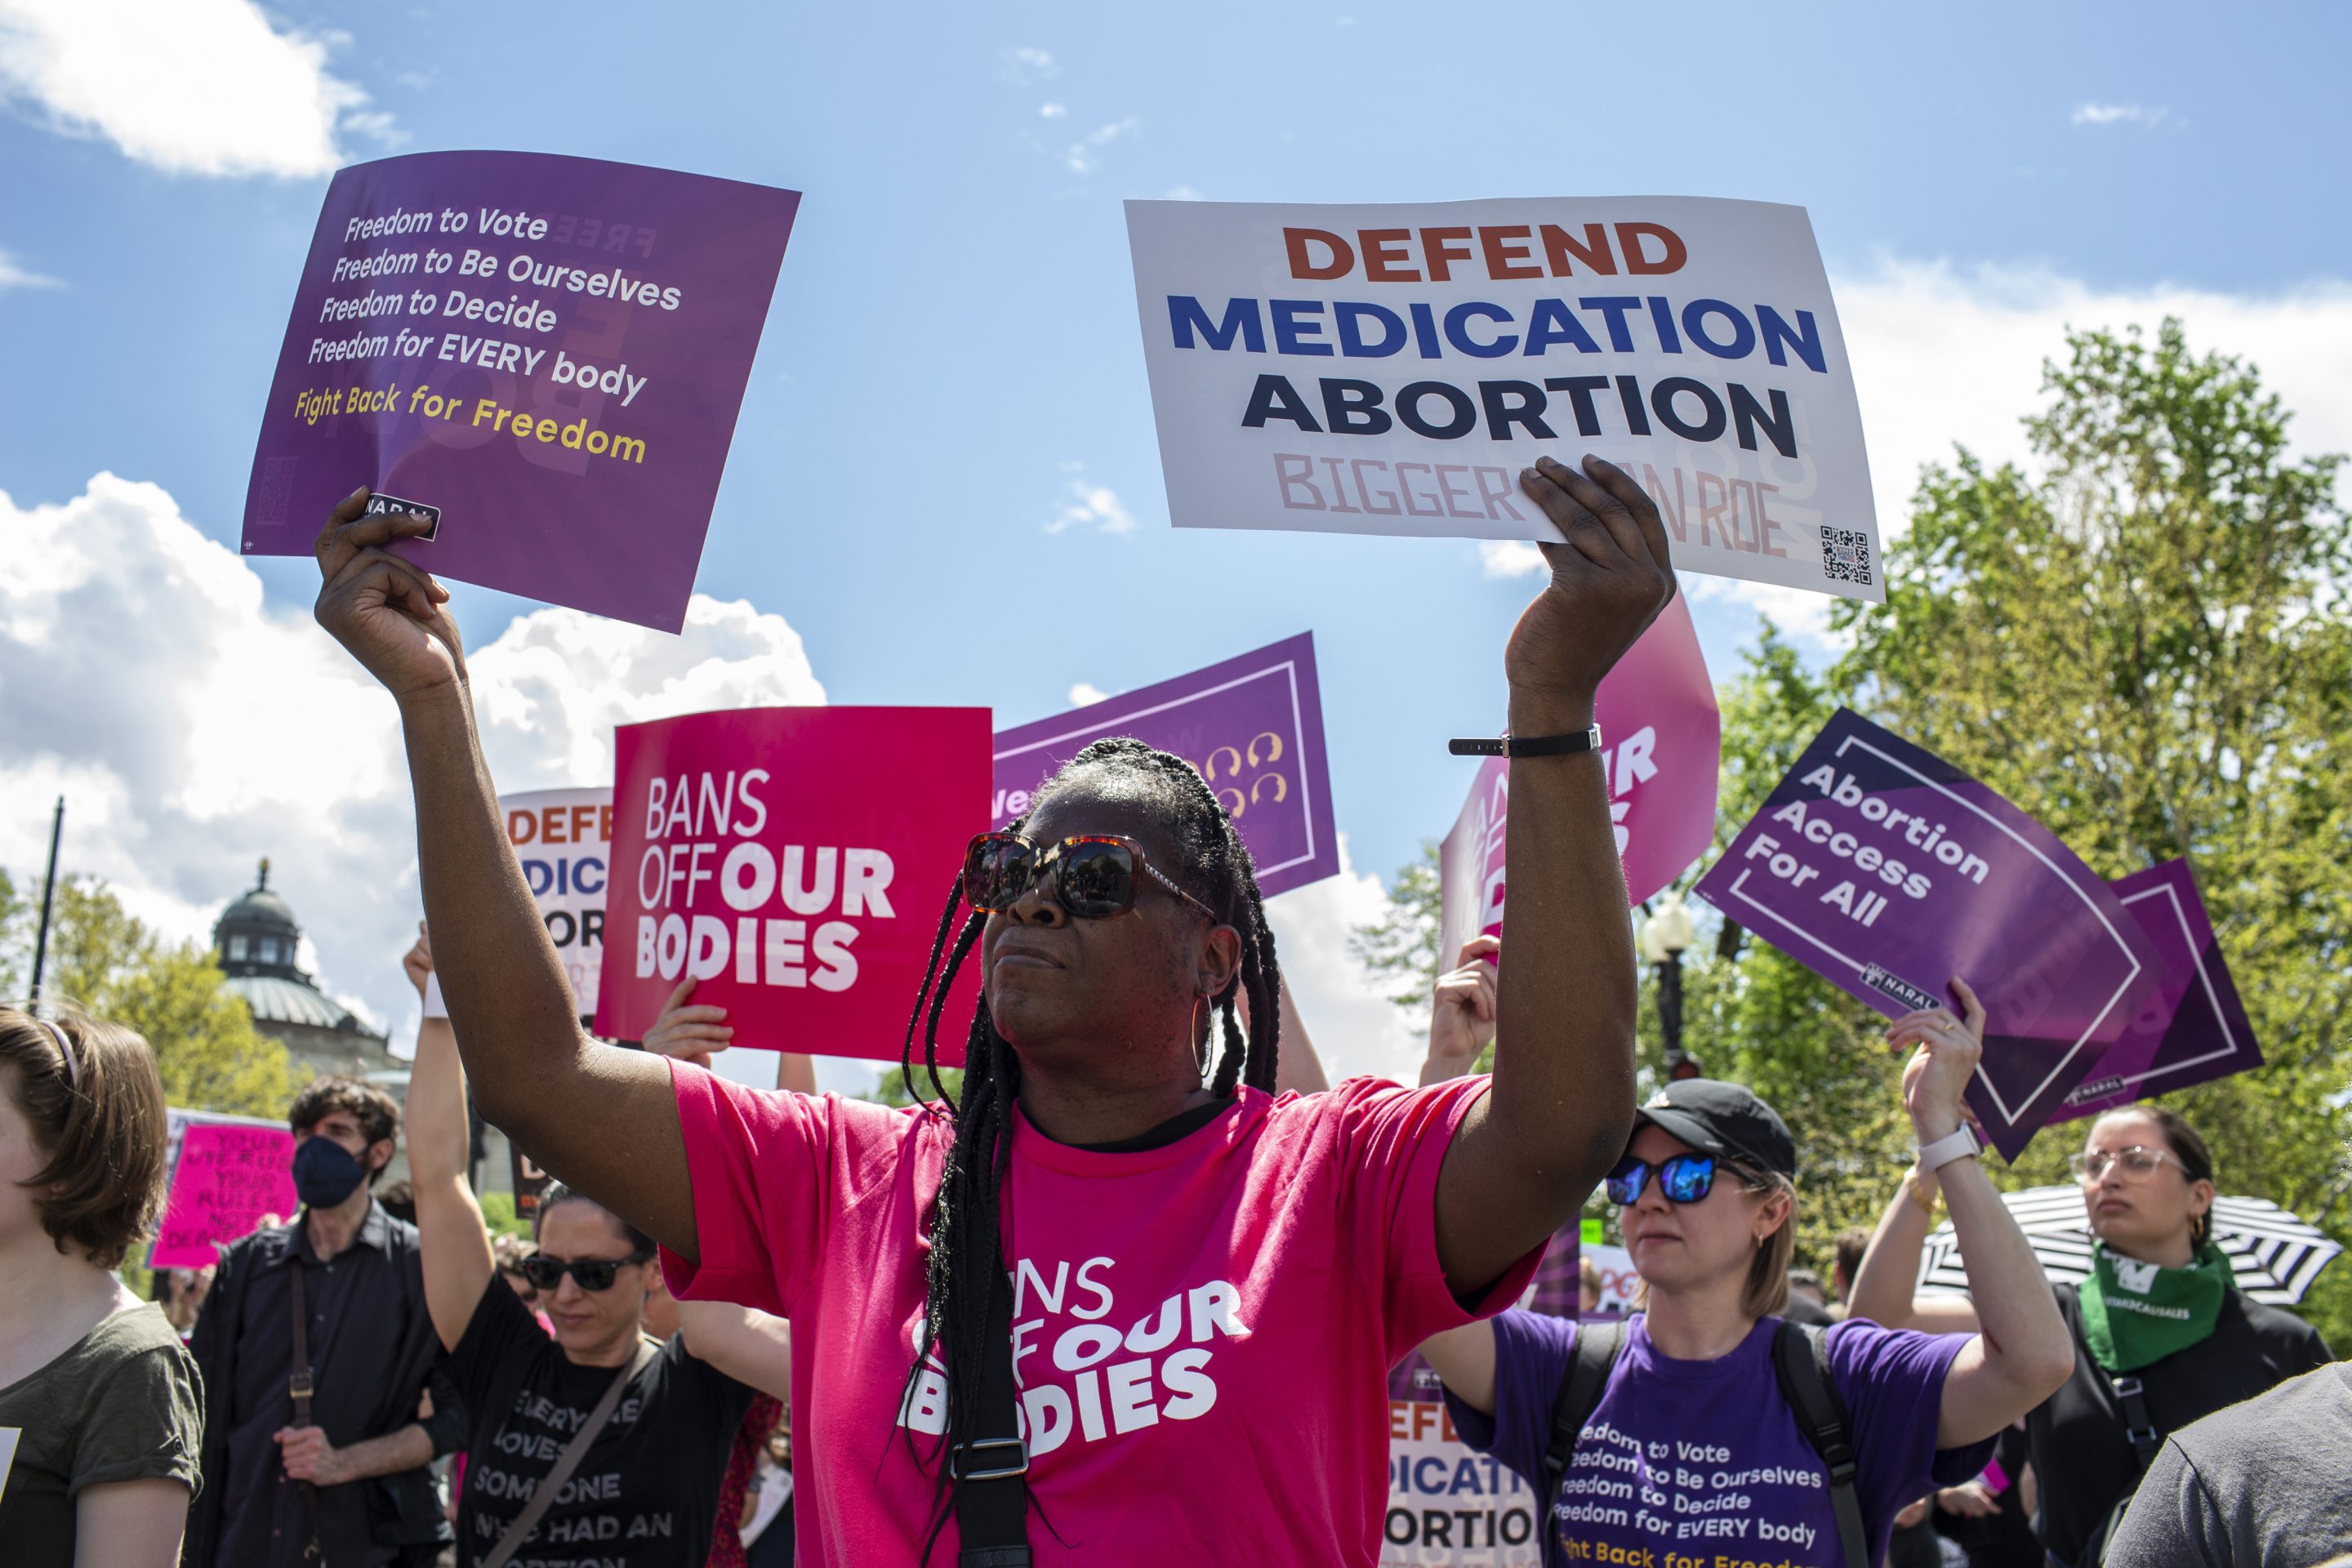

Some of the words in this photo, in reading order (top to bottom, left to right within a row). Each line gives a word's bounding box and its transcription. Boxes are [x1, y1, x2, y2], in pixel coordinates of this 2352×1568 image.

[344, 207, 433, 243] Freedom
[439, 207, 469, 233] to
[479, 208, 548, 240] Vote
[1283, 221, 1687, 282] DEFEND
[319, 289, 403, 323] Freedom
[408, 289, 437, 315] to
[443, 290, 557, 332] Decide
[332, 248, 418, 283] Freedom
[424, 248, 452, 274] to
[458, 249, 498, 278] Be
[507, 255, 682, 310] Ourselves
[308, 331, 389, 364] Freedom
[393, 327, 434, 357] for
[438, 333, 546, 376] EVERY
[550, 351, 648, 407] body
[1167, 295, 1828, 374] MEDICATION
[294, 387, 342, 425] Fight
[345, 383, 401, 414] Back
[408, 385, 463, 421] for
[472, 398, 646, 464] Freedom
[1241, 374, 1797, 459] ABORTION
[1273, 453, 1527, 521] BIGGER
[1696, 470, 1787, 558] ROE
[645, 768, 770, 840] BANS
[1800, 764, 1989, 884] Abortion
[639, 843, 716, 910] OFF
[719, 842, 896, 918] OUR
[1744, 833, 1820, 888] For
[1820, 881, 1888, 928] All
[1772, 800, 1932, 899] Access
[635, 914, 860, 992] BODIES
[1053, 1280, 1251, 1371] OUR
[896, 1348, 1217, 1458] BDIES
[474, 1466, 621, 1505] SOMONE
[1644, 1464, 1671, 1485] to
[1676, 1468, 1704, 1490] Be
[1710, 1466, 1822, 1489] Ourselves
[1648, 1441, 1669, 1459] to
[1677, 1441, 1731, 1463] Vote
[548, 1516, 620, 1543] HAD
[626, 1512, 672, 1539] AN
[1635, 1509, 1672, 1535] for
[1677, 1517, 1750, 1539] EVERY
[1758, 1517, 1815, 1550] body
[1640, 1485, 1668, 1507] to
[1674, 1492, 1752, 1515] Decide
[1596, 1541, 1655, 1568] Back
